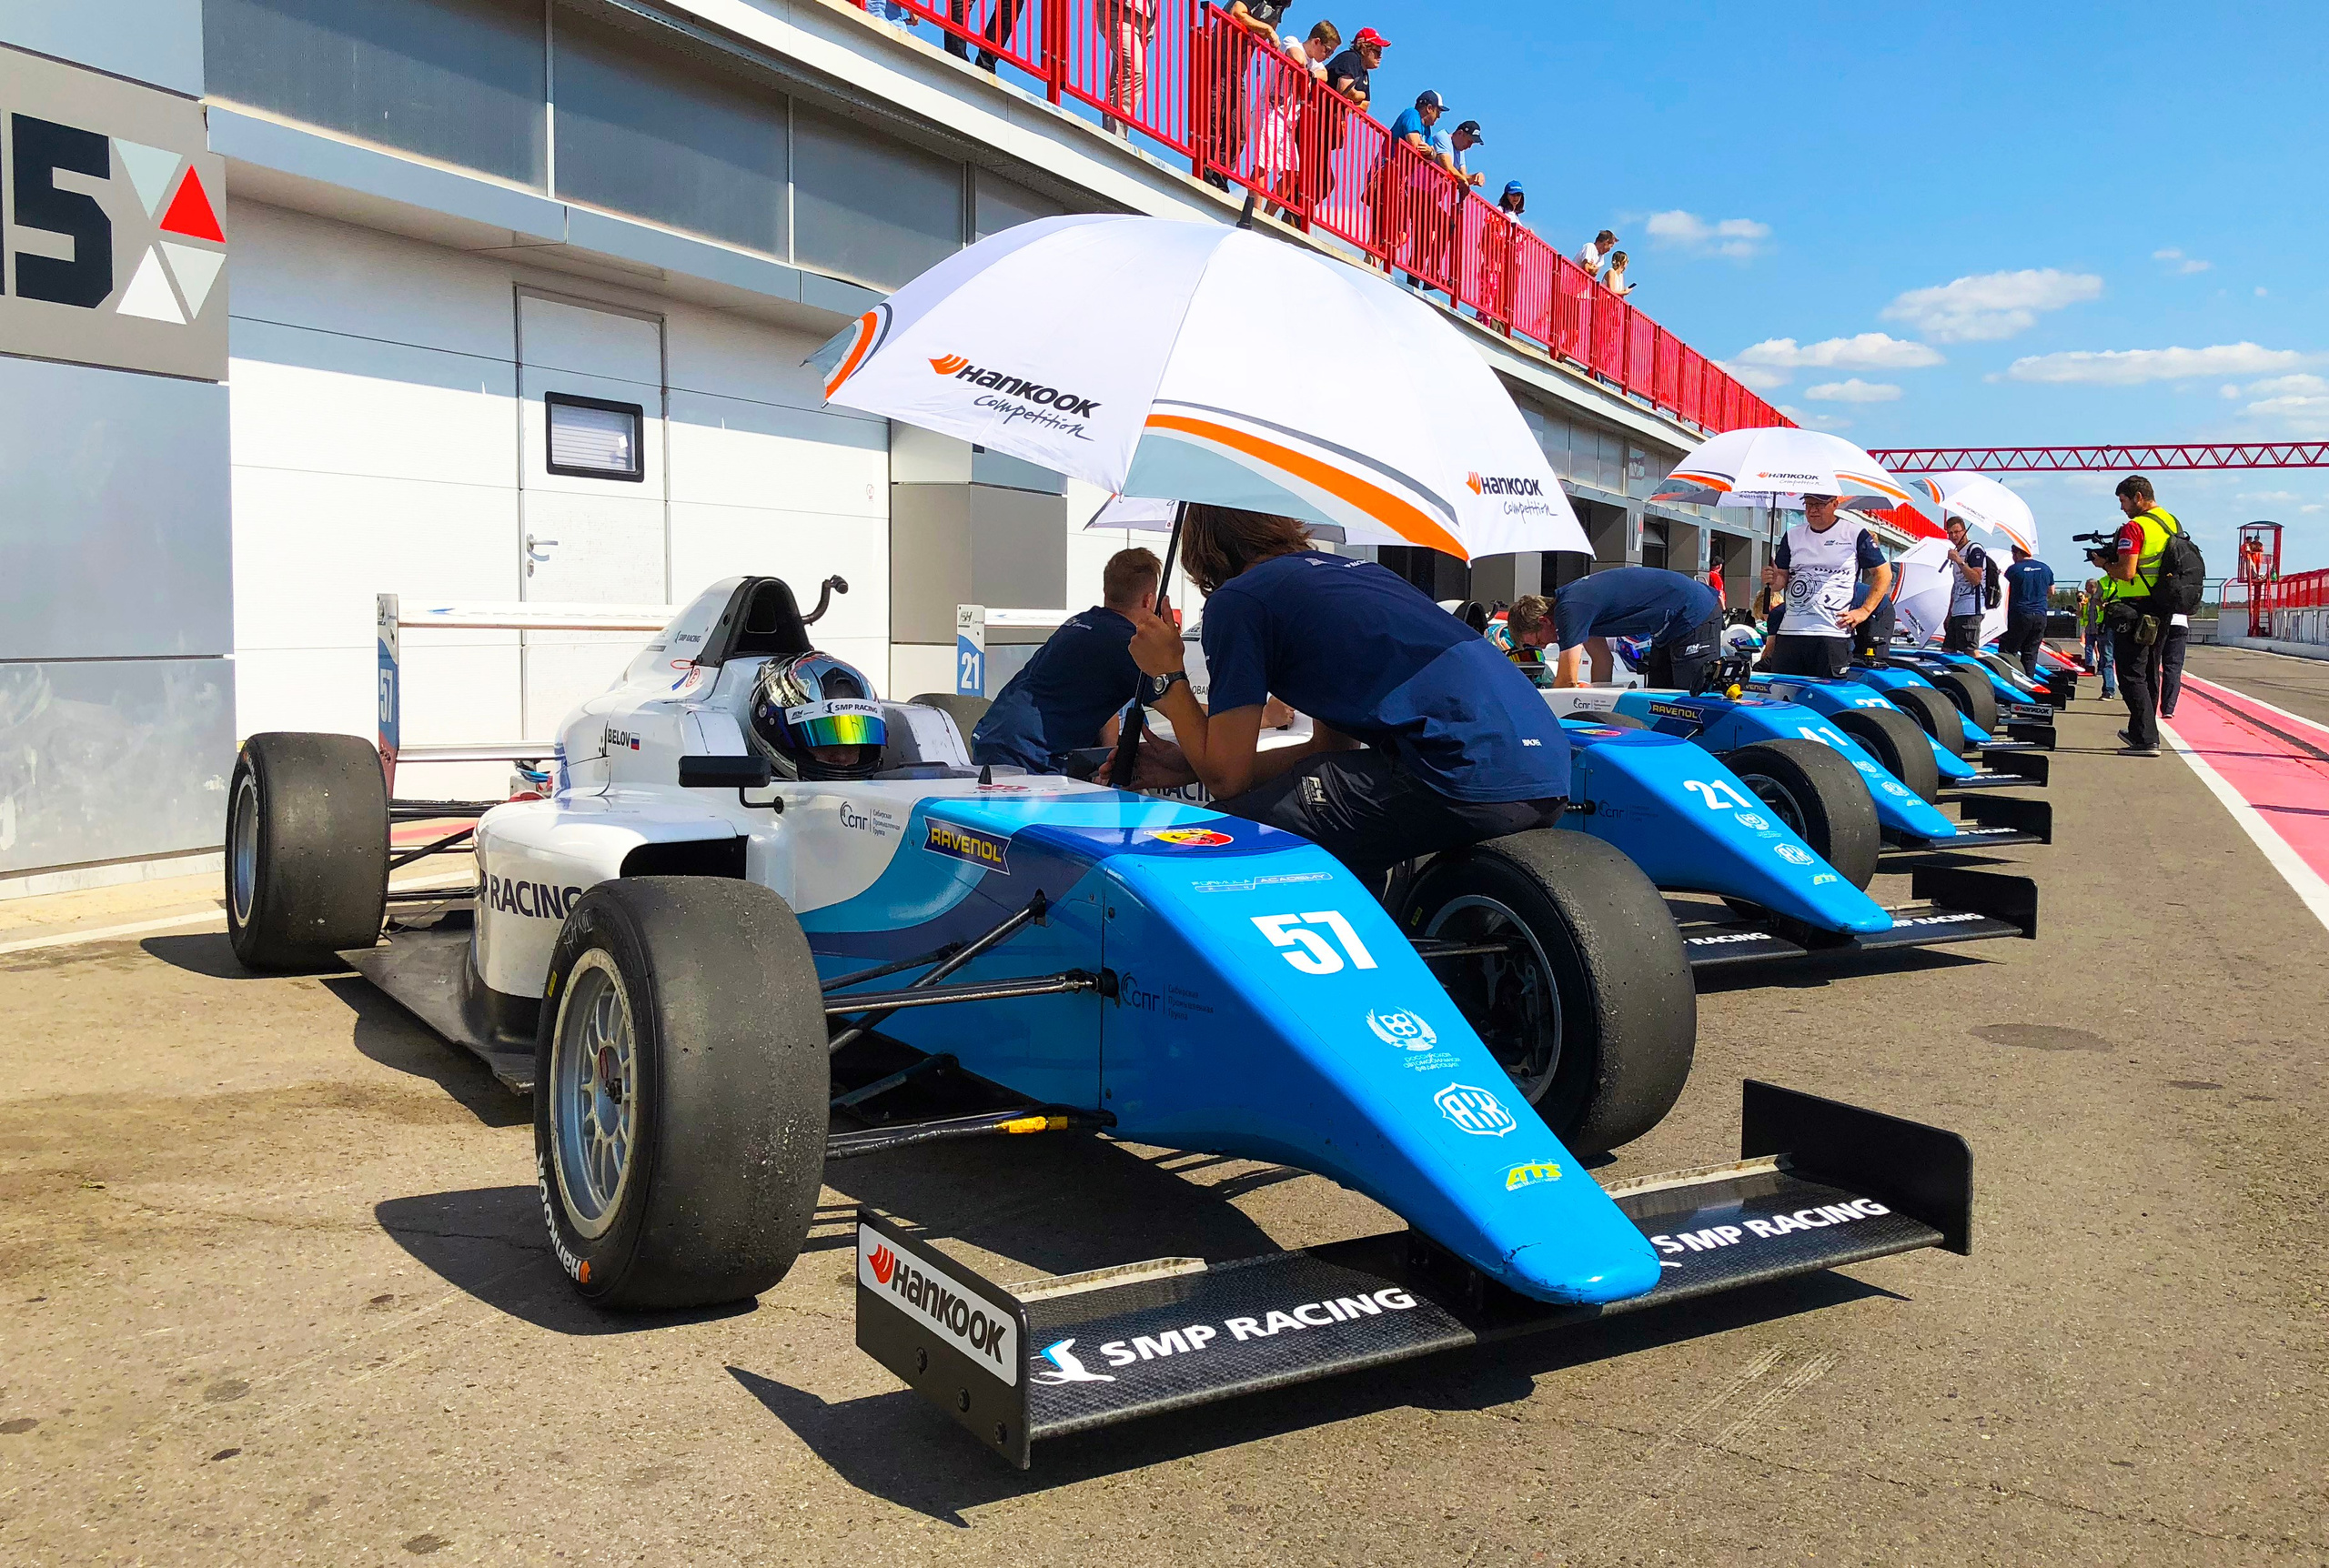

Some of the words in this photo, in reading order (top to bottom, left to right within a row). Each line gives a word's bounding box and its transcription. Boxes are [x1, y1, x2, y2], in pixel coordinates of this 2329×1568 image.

[962, 652, 979, 689] 21
[379, 668, 393, 723] 57
[854, 705, 878, 714] RACING
[1652, 704, 1698, 719] RAVENOL
[608, 729, 631, 747] BELOV
[1683, 779, 1754, 810] 21
[931, 828, 1002, 863] RAVENOL
[1260, 873, 1326, 883] ACADEMY
[1913, 912, 1986, 926] RACING
[1249, 910, 1379, 975] 57
[1692, 932, 1772, 946] RACING
[1650, 1225, 1743, 1254] SMP
[1742, 1198, 1890, 1239] RACING
[1100, 1325, 1217, 1367] SMP
[1224, 1288, 1418, 1342] RACING
